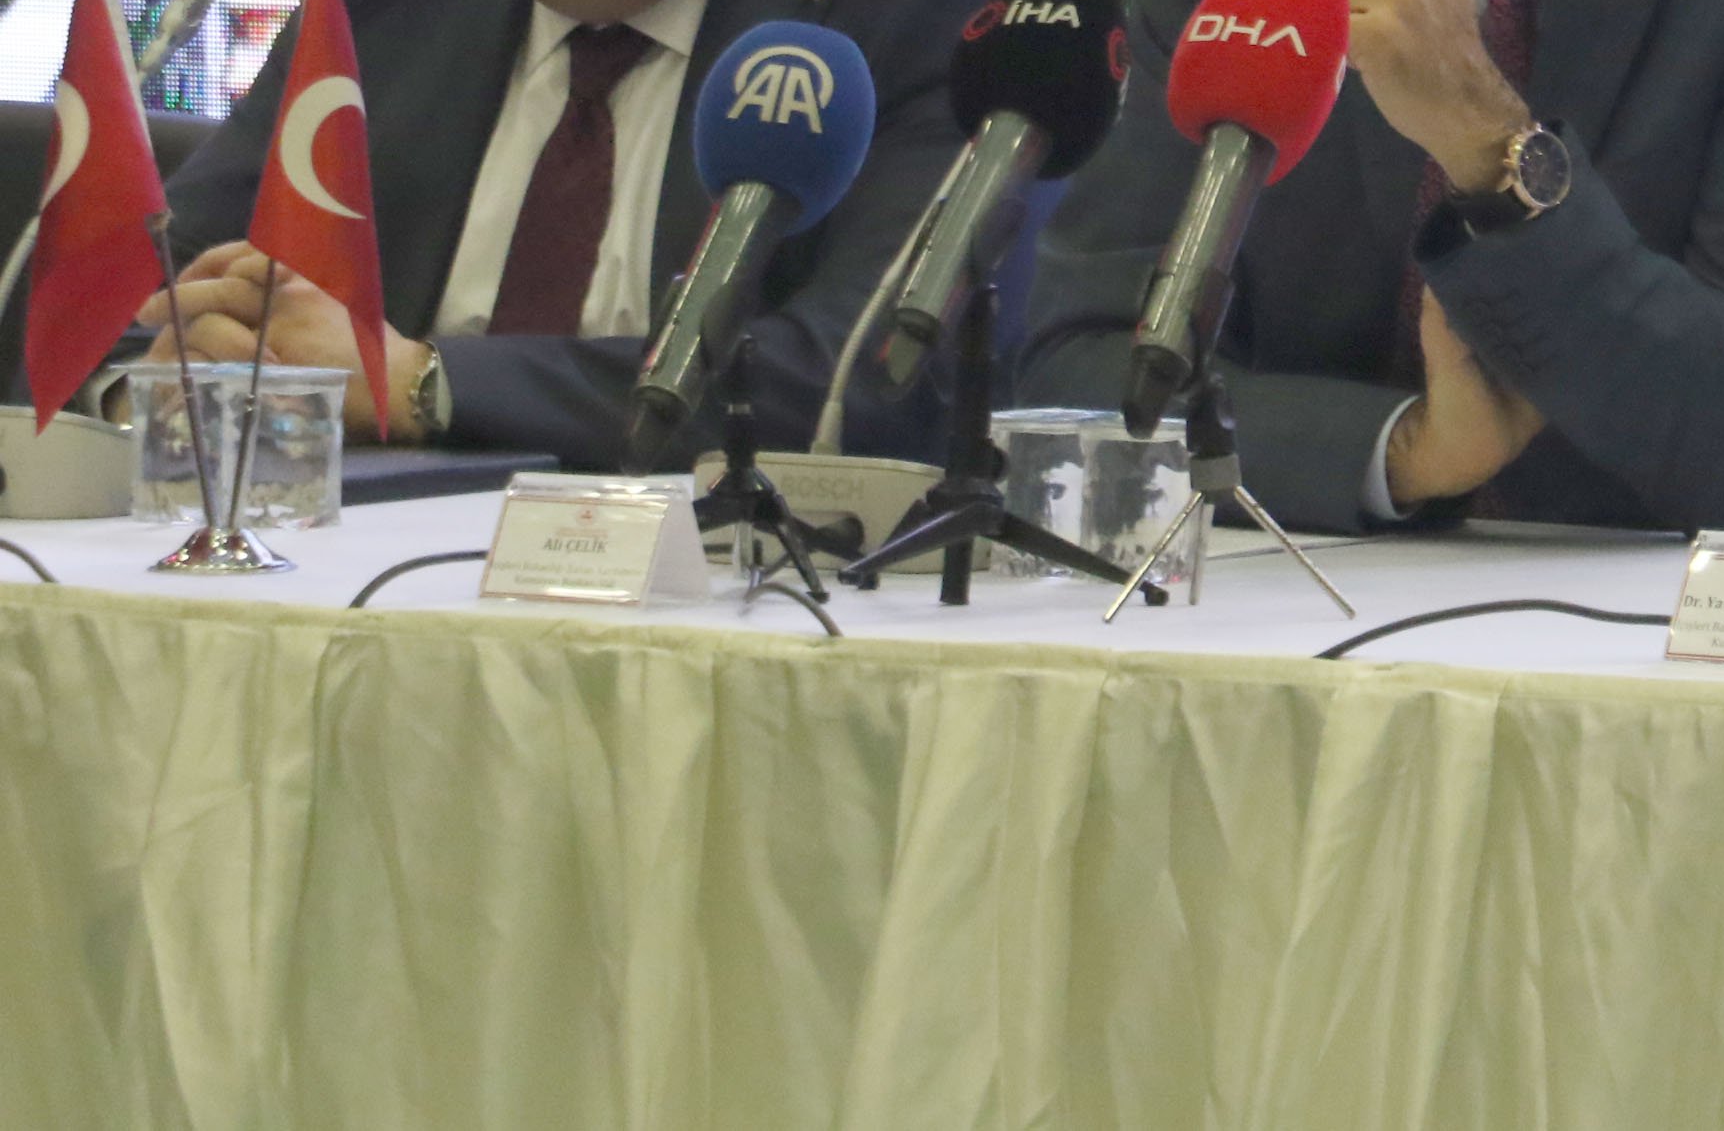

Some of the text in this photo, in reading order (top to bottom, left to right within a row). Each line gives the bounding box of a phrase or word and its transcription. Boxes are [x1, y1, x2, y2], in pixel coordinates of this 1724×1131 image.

[1187, 14, 1307, 57] DHA
[726, 63, 823, 135] AA
[543, 537, 563, 552] Ali
[1683, 594, 1703, 608] Dr.
